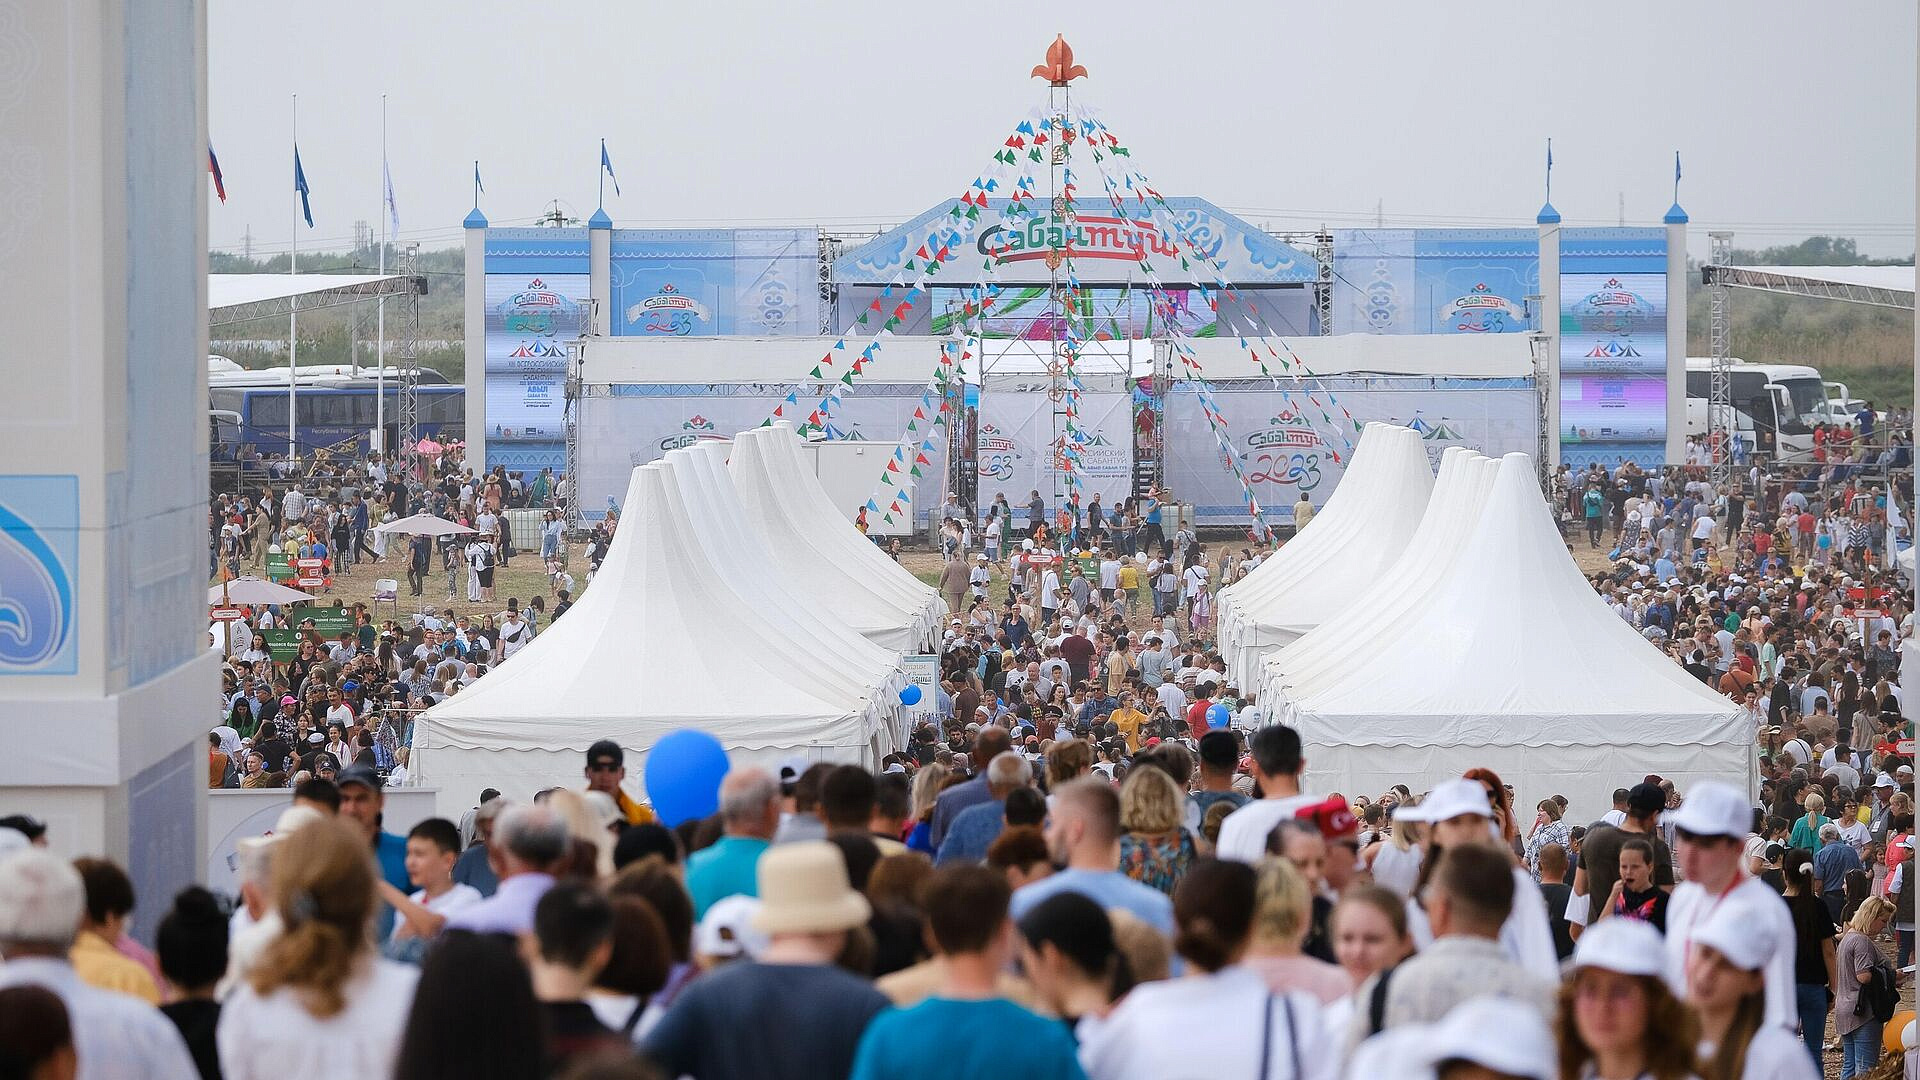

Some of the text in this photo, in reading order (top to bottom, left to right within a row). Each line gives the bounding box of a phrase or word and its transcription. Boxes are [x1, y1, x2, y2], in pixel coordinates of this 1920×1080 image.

[644, 296, 694, 310] Сабантуй
[1456, 295, 1505, 309] Сабантуй
[645, 312, 692, 336] 2023
[1457, 312, 1504, 333] 2023
[1247, 428, 1324, 450] Сабантуй
[1250, 454, 1322, 491] 2023
